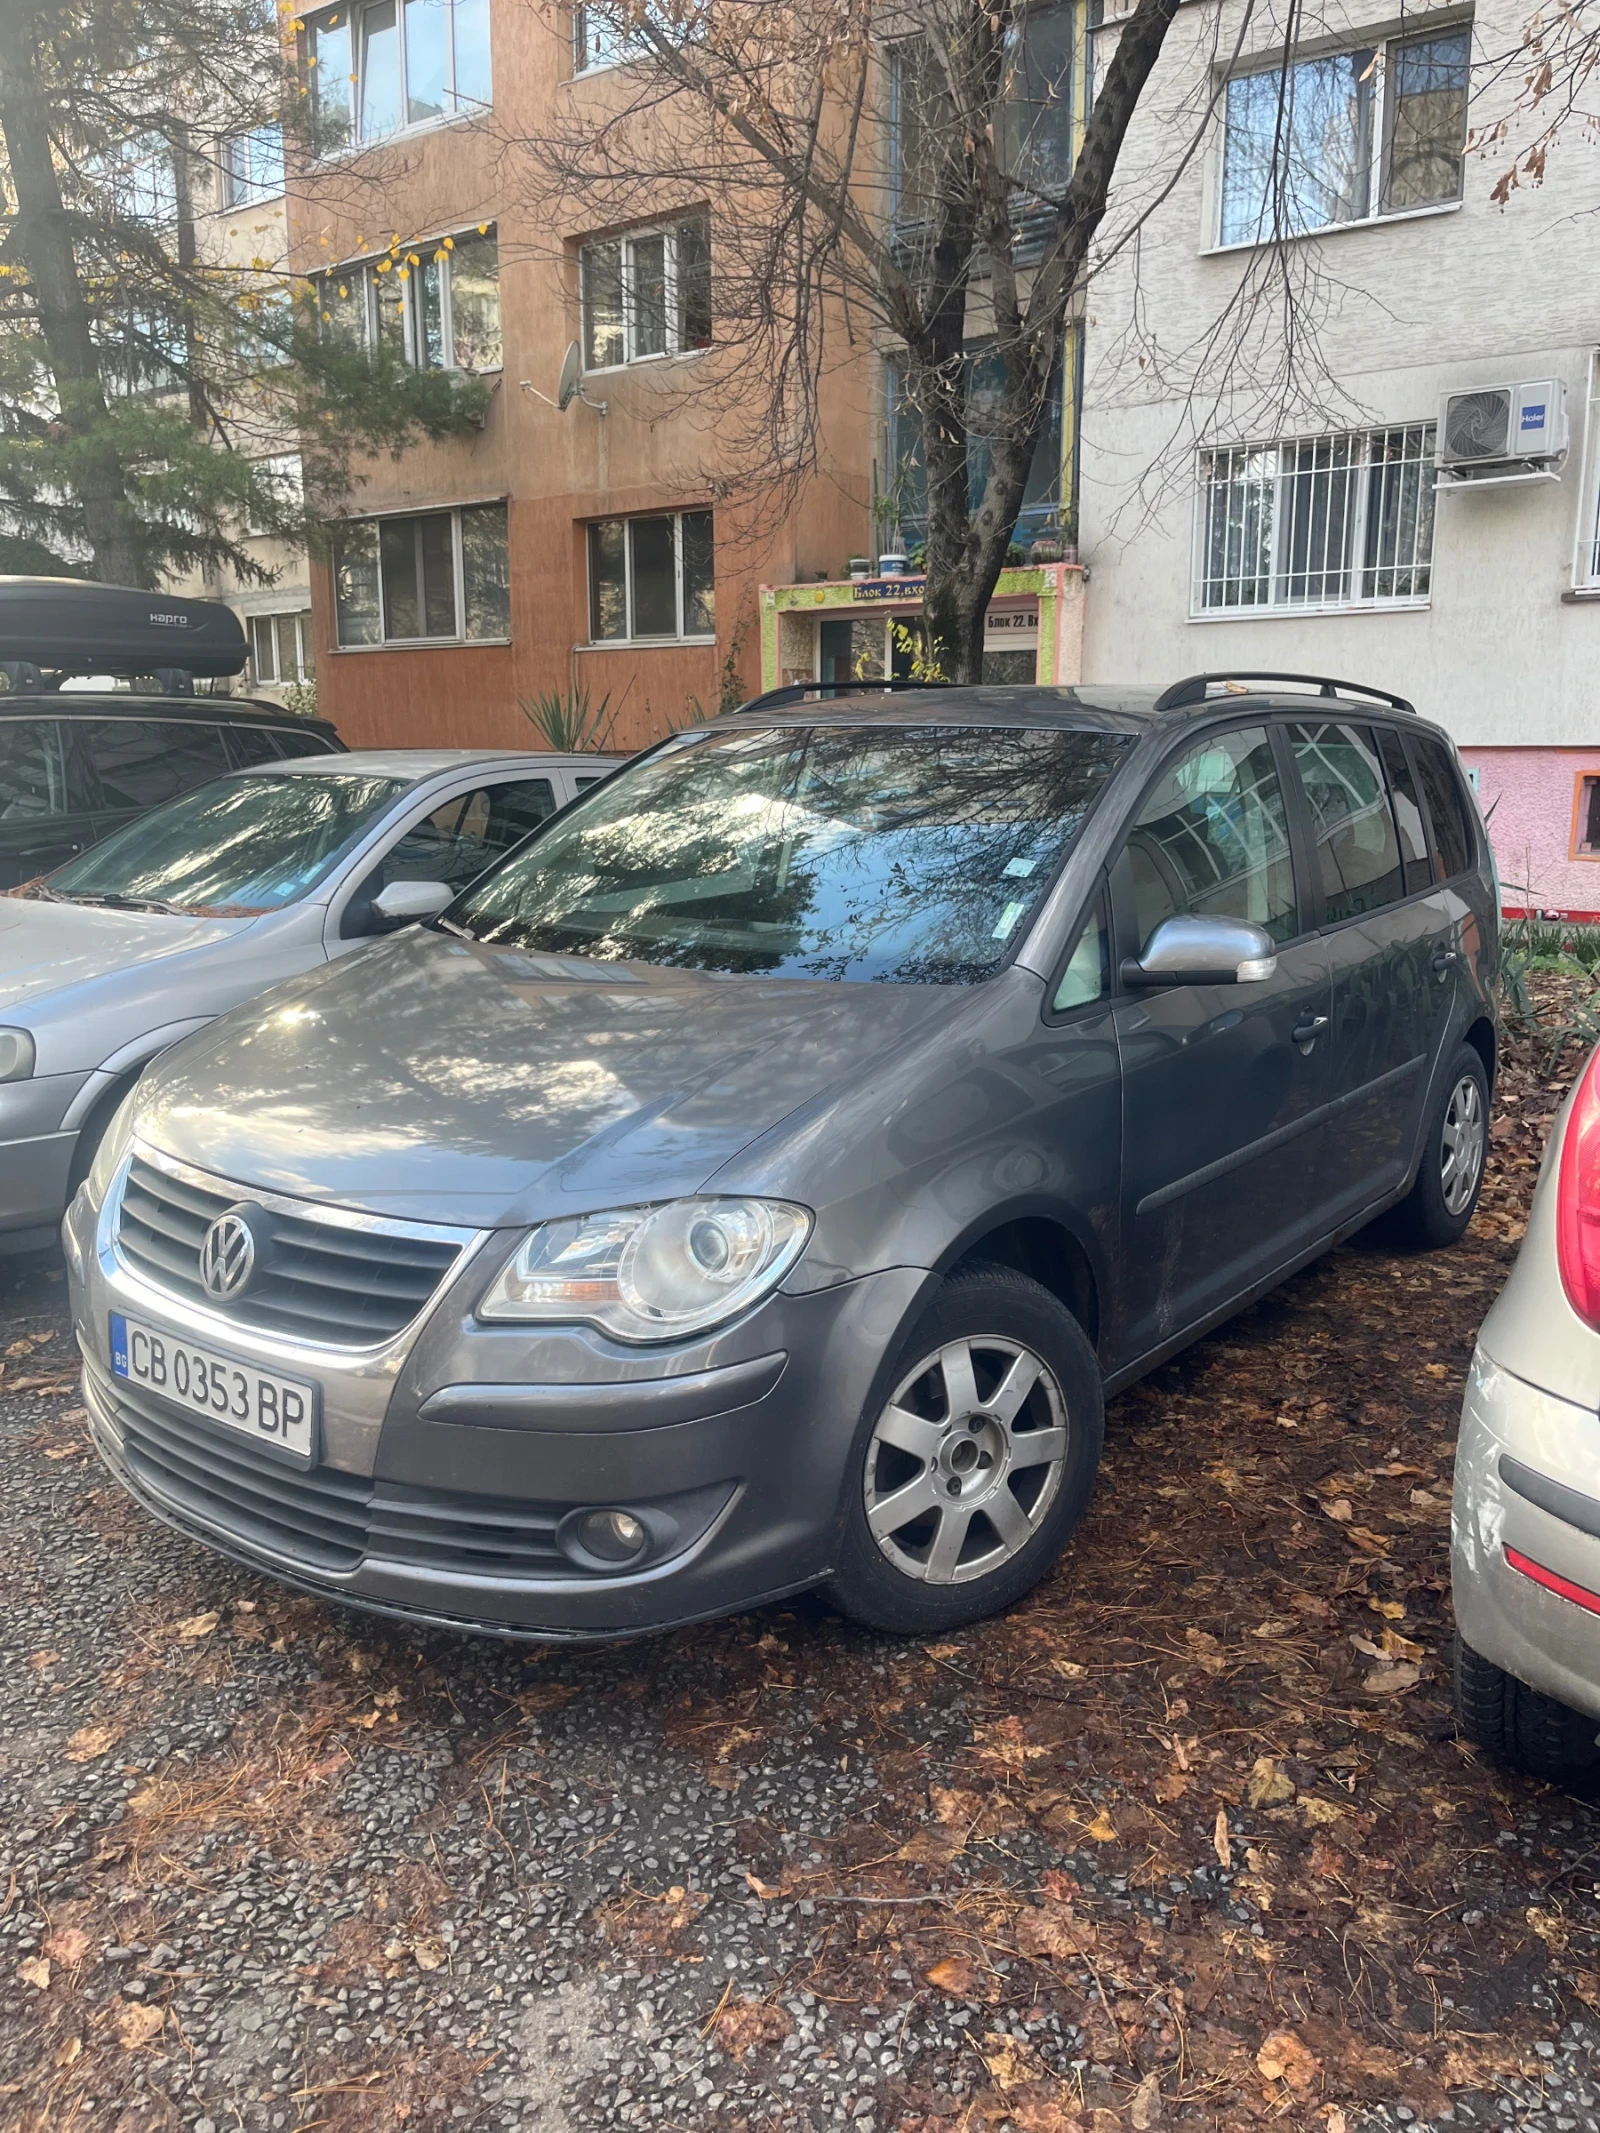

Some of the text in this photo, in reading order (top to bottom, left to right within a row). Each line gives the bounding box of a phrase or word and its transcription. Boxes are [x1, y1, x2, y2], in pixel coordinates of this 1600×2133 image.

[1521, 413, 1545, 423] Haier
[854, 586, 882, 598] Блок
[988, 616, 1011, 628] Блок
[203, 1216, 252, 1299] VW
[115, 1351, 128, 1368] BG
[173, 1348, 250, 1421] 0353
